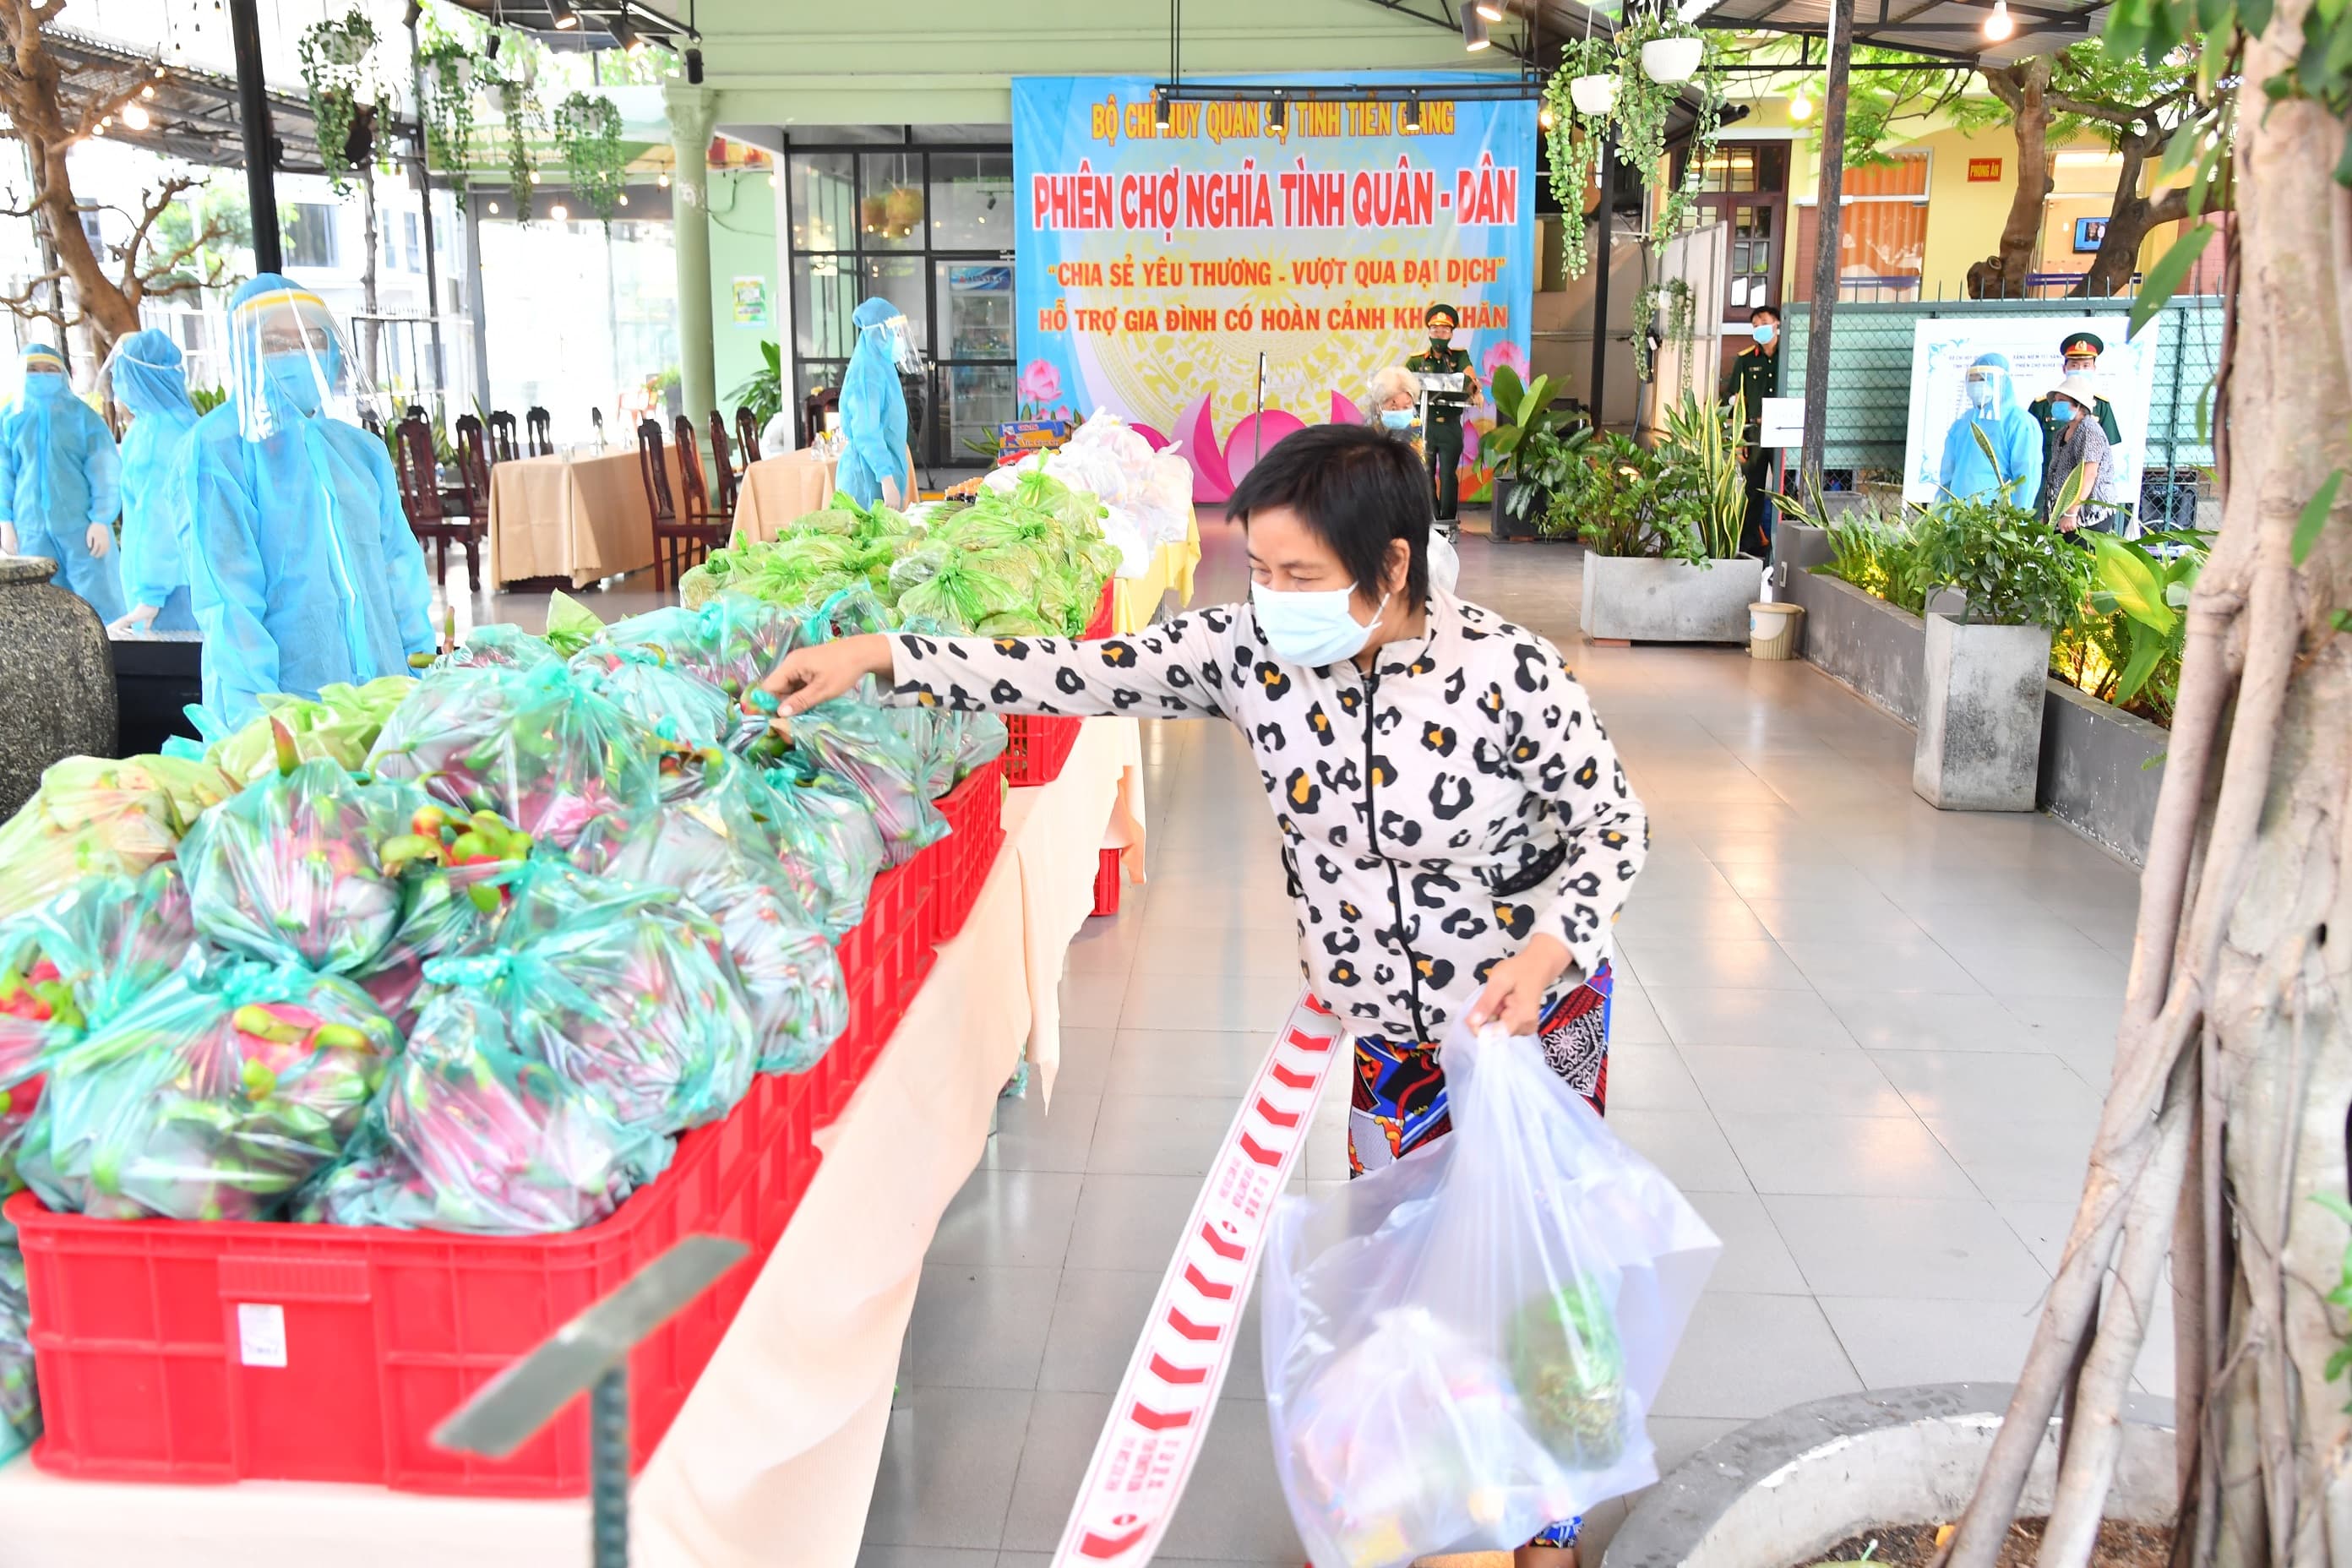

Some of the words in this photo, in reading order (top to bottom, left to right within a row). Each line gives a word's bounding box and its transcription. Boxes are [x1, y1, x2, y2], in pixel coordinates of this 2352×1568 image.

[1092, 94, 1119, 146] BỘ
[1124, 90, 1157, 139] CHỈ
[1206, 93, 1259, 144] QUÂN
[1396, 101, 1455, 136] GANG
[1034, 159, 1113, 229] PHIÊN
[1121, 167, 1179, 242] CHỢ
[1186, 159, 1273, 228] NGHĨA
[1280, 156, 1345, 227] TÌNH
[1353, 155, 1434, 228] QUÂN
[1457, 152, 1516, 224] DÂN
[1109, 253, 1135, 287] SẺ
[1143, 256, 1183, 287] YÊU
[1190, 258, 1271, 286] THƯƠNG
[1292, 258, 1347, 290] VƯỢT
[1354, 260, 1395, 288] QUA
[1403, 259, 1440, 288] ĐẠI
[1038, 298, 1068, 332] HỖ
[1075, 306, 1119, 336] TRỢ
[1124, 309, 1159, 332] GIA
[1166, 303, 1217, 332] ĐÌNH
[1224, 302, 1253, 332] CÓ
[1261, 302, 1320, 330] HOÀN
[1327, 300, 1386, 330] CẢNH
